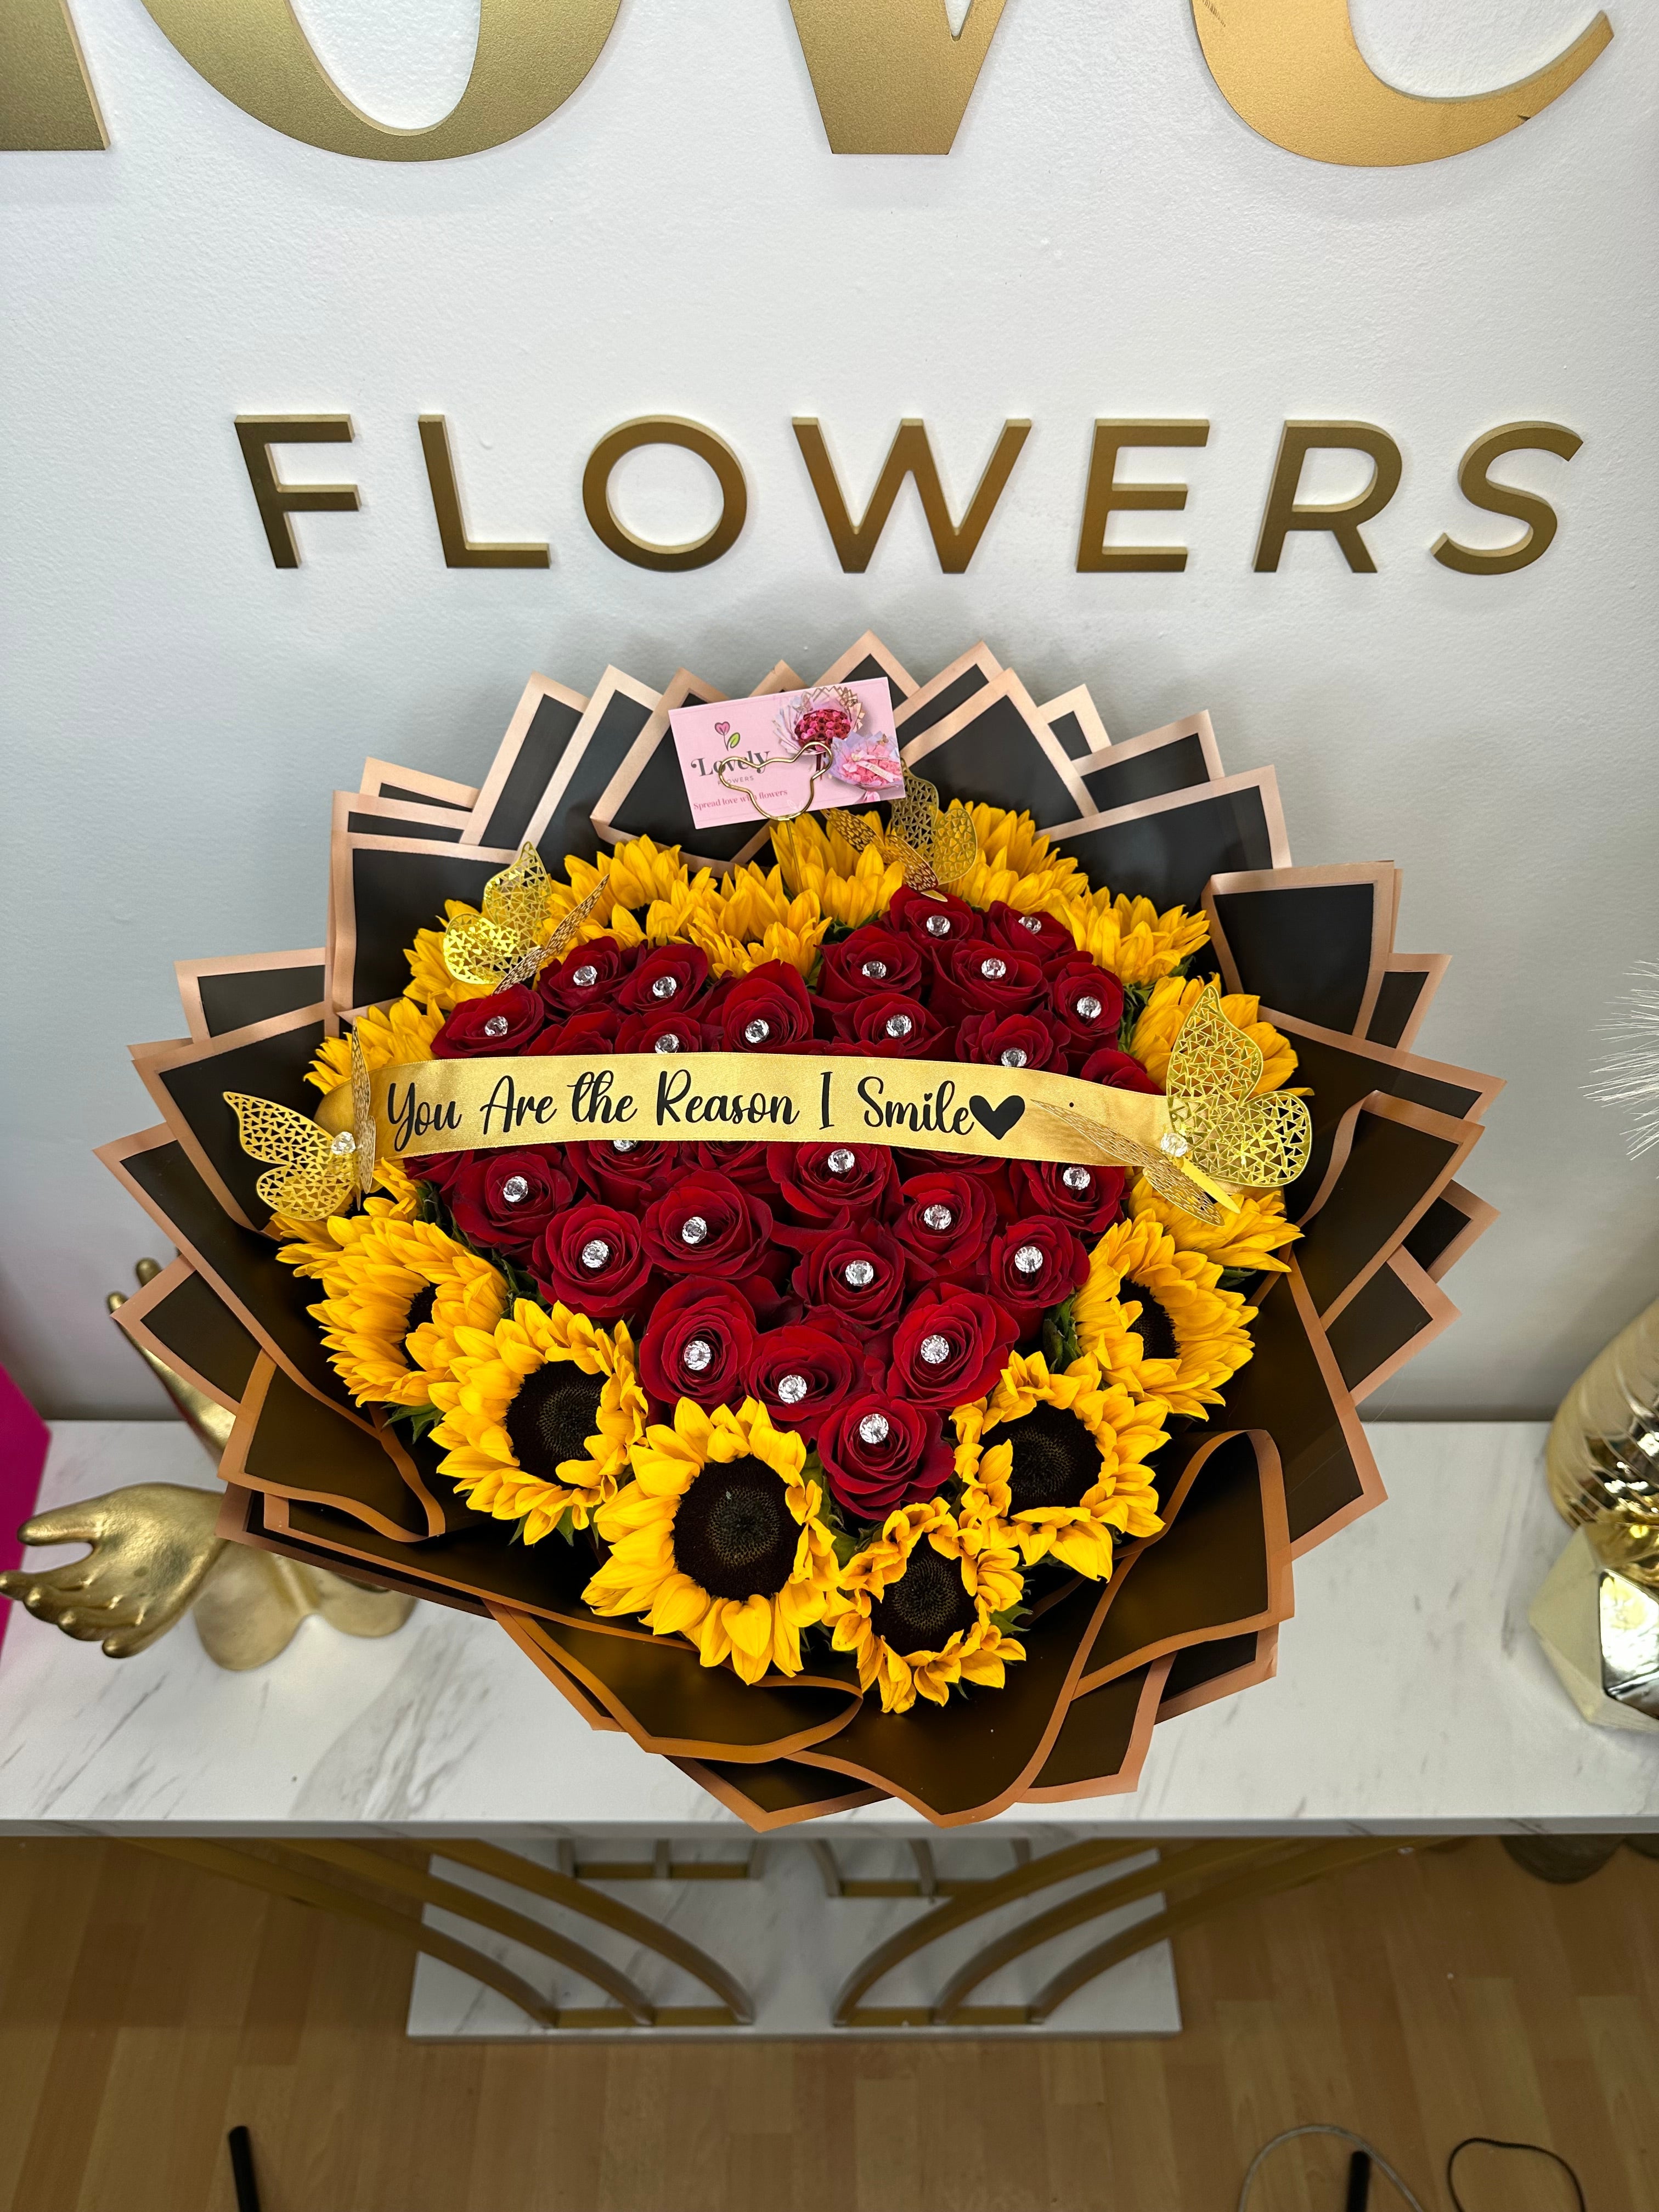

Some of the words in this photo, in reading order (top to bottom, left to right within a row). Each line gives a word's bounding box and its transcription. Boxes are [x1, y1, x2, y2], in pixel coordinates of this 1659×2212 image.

[234, 415, 1583, 575] FLOWERS
[691, 751, 770, 777] Lovely
[718, 776, 754, 786] FOWERS
[693, 799, 721, 811] Spread
[723, 797, 738, 806] love
[759, 789, 788, 800] flowers
[387, 1082, 462, 1152] You
[480, 1076, 557, 1135] Are
[567, 1070, 637, 1124] the
[657, 1069, 799, 1126] Reason
[819, 1071, 835, 1130] I
[858, 1076, 974, 1135] Smile
